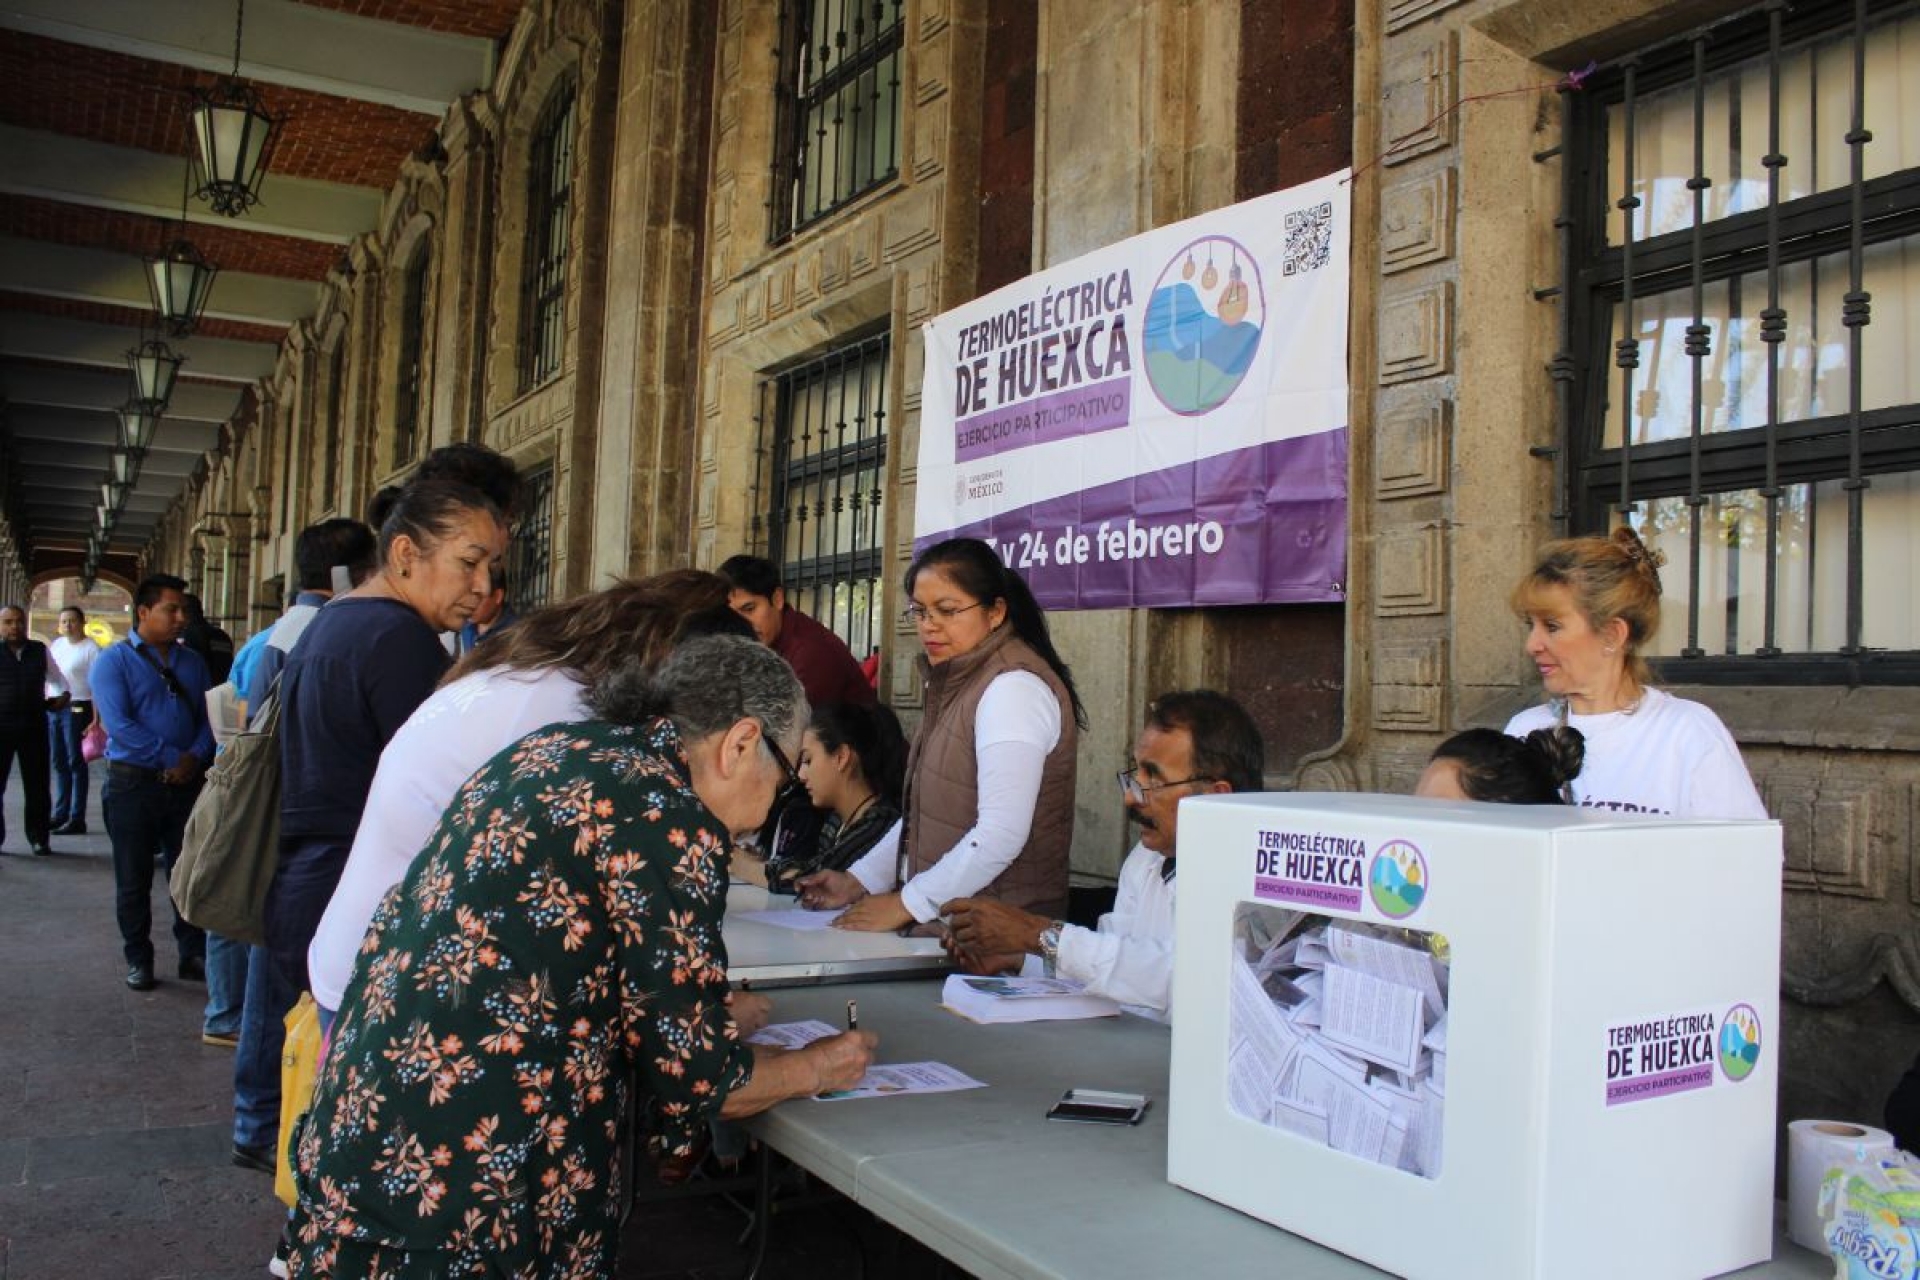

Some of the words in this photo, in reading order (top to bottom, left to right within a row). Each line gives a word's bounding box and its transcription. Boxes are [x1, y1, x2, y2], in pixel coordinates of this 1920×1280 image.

[958, 268, 1133, 361] TERMOELÉCTRICA
[956, 356, 988, 417] DE
[998, 314, 1131, 405] HUEXCA
[957, 419, 1012, 449] EJERCICIO
[1015, 394, 1124, 434] PARTICIPATIVO
[1019, 531, 1048, 568] 24
[1055, 526, 1090, 565] de
[1096, 519, 1224, 562] febrero
[1256, 849, 1280, 875] DE
[1286, 852, 1363, 887] HUEXCA
[1258, 831, 1366, 859] TERMOELÉCTRICA
[1608, 1012, 1714, 1047] TERMOELÉCTRICA
[1607, 1047, 1633, 1079] DE
[1641, 1034, 1713, 1074] HUEXCA
